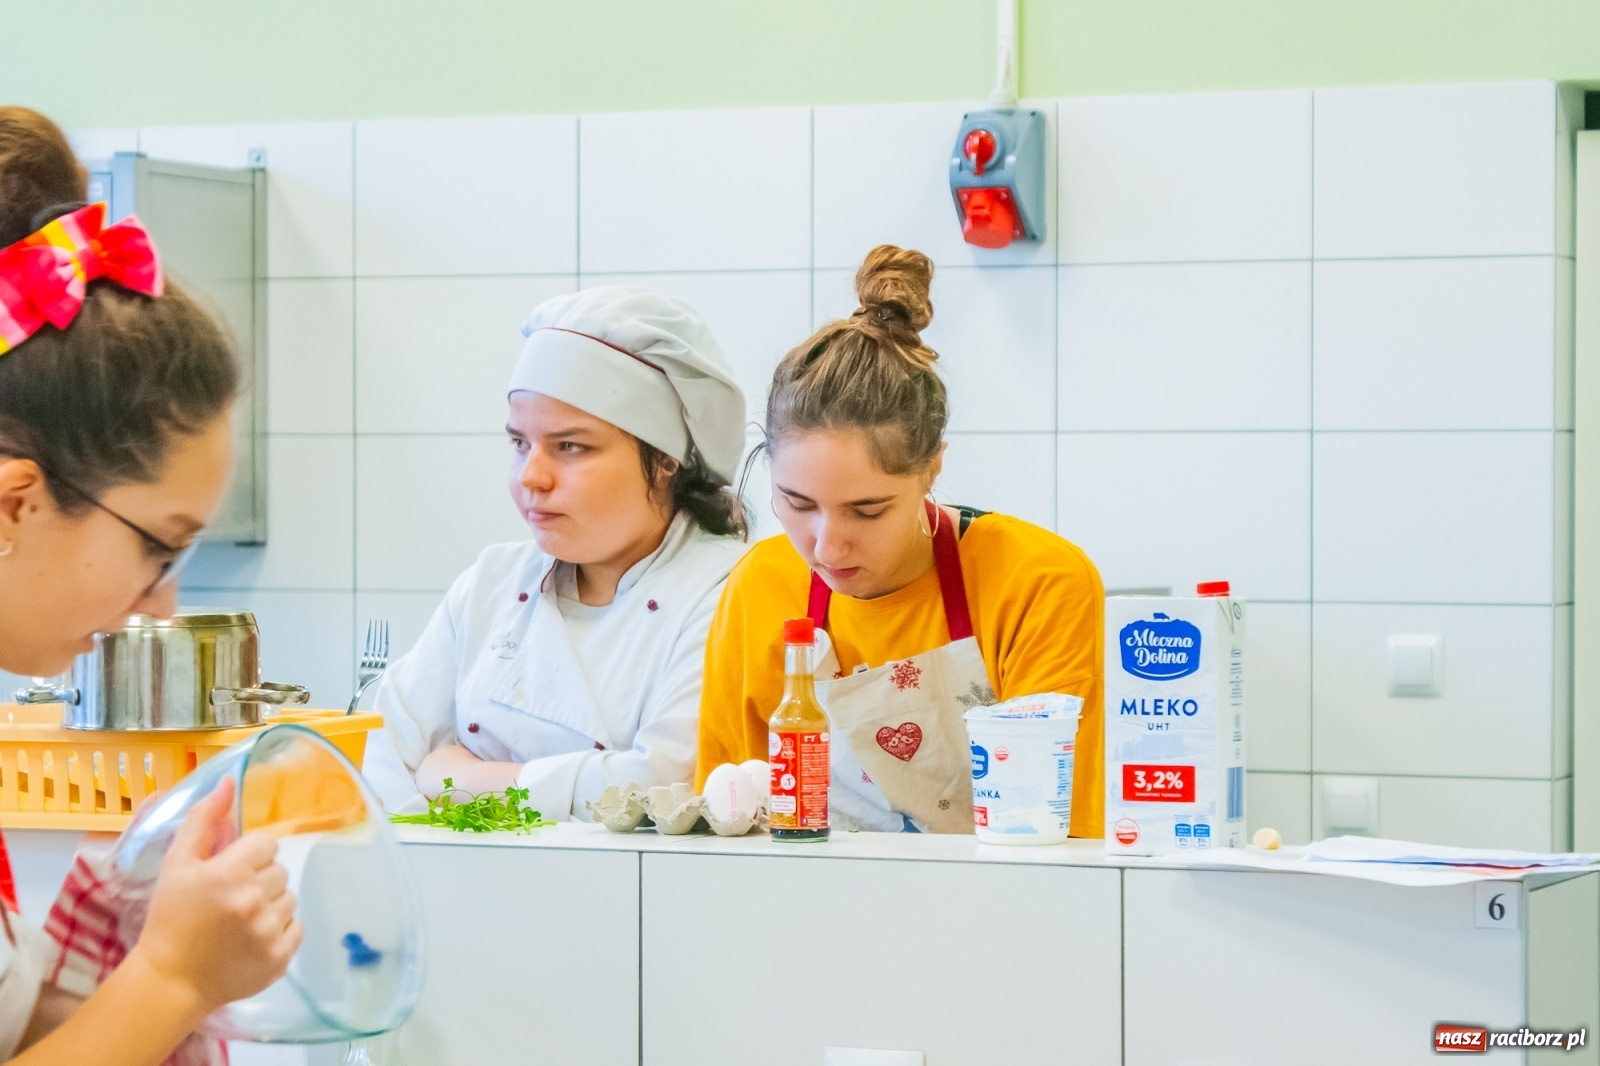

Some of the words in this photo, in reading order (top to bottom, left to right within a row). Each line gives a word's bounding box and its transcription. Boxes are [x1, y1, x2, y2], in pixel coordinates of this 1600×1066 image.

[1126, 628, 1194, 648] Mleczna
[1134, 647, 1189, 667] Dolina
[1120, 698, 1198, 716] MLEKO
[1147, 722, 1170, 731] UHT
[1133, 770, 1184, 792] 3,2%
[1488, 893, 1505, 921] 6
